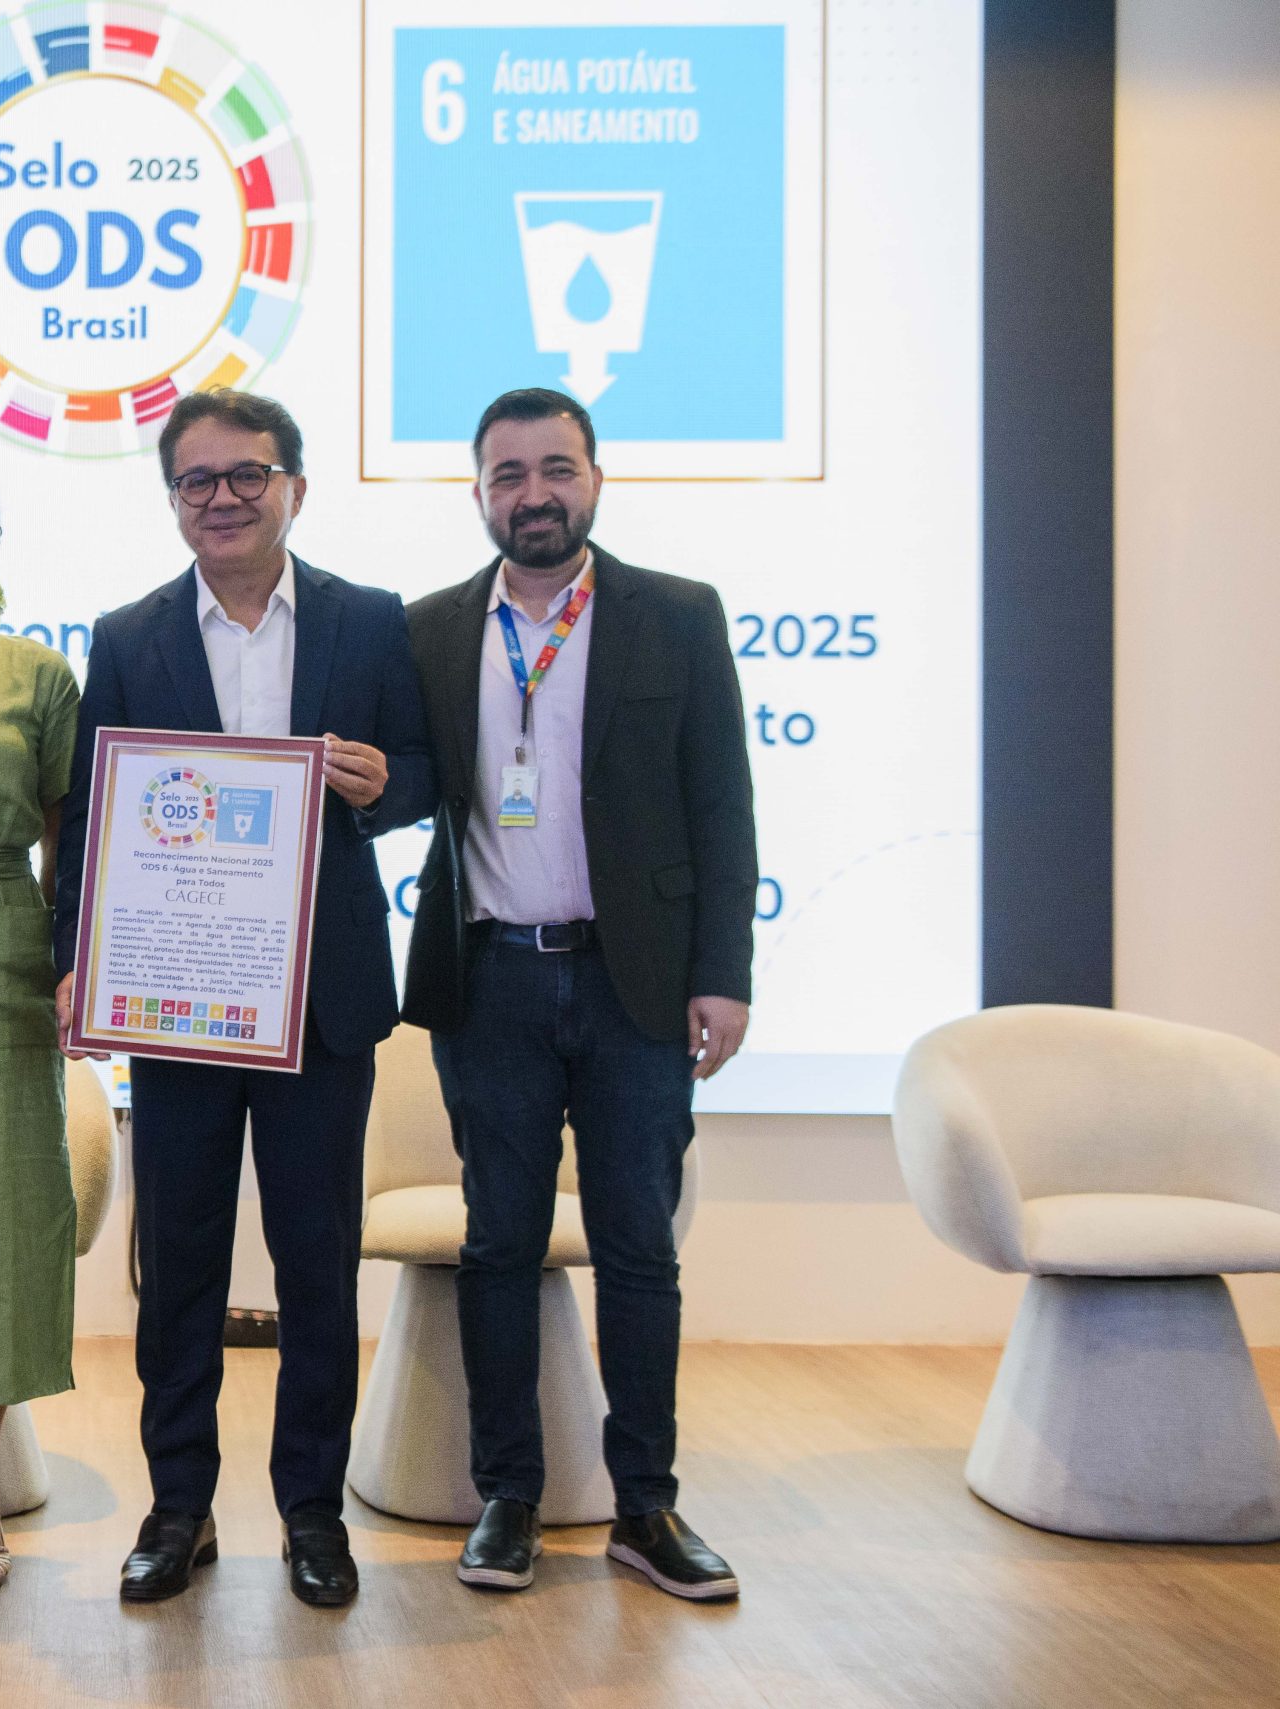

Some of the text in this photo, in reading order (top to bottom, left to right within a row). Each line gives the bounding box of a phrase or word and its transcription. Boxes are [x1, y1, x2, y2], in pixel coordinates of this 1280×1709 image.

[422, 50, 697, 144] 6 ÁGUA POTÁVEL
[493, 108, 699, 144] E SANEAMENTO
[127, 158, 200, 181] 2025
[4, 209, 204, 291] ODS
[42, 306, 148, 339] Brasil
[735, 614, 878, 658] 2025
[160, 792, 181, 802] Selo
[162, 804, 198, 820] ODS
[167, 821, 188, 829] Brasil
[133, 850, 274, 867] Reconhecimento Nacional 2025
[141, 863, 160, 872] ODS
[162, 864, 168, 872] 6
[206, 867, 263, 879] Saneamento
[176, 878, 225, 888] para Todos
[165, 888, 226, 906] CAGECE
